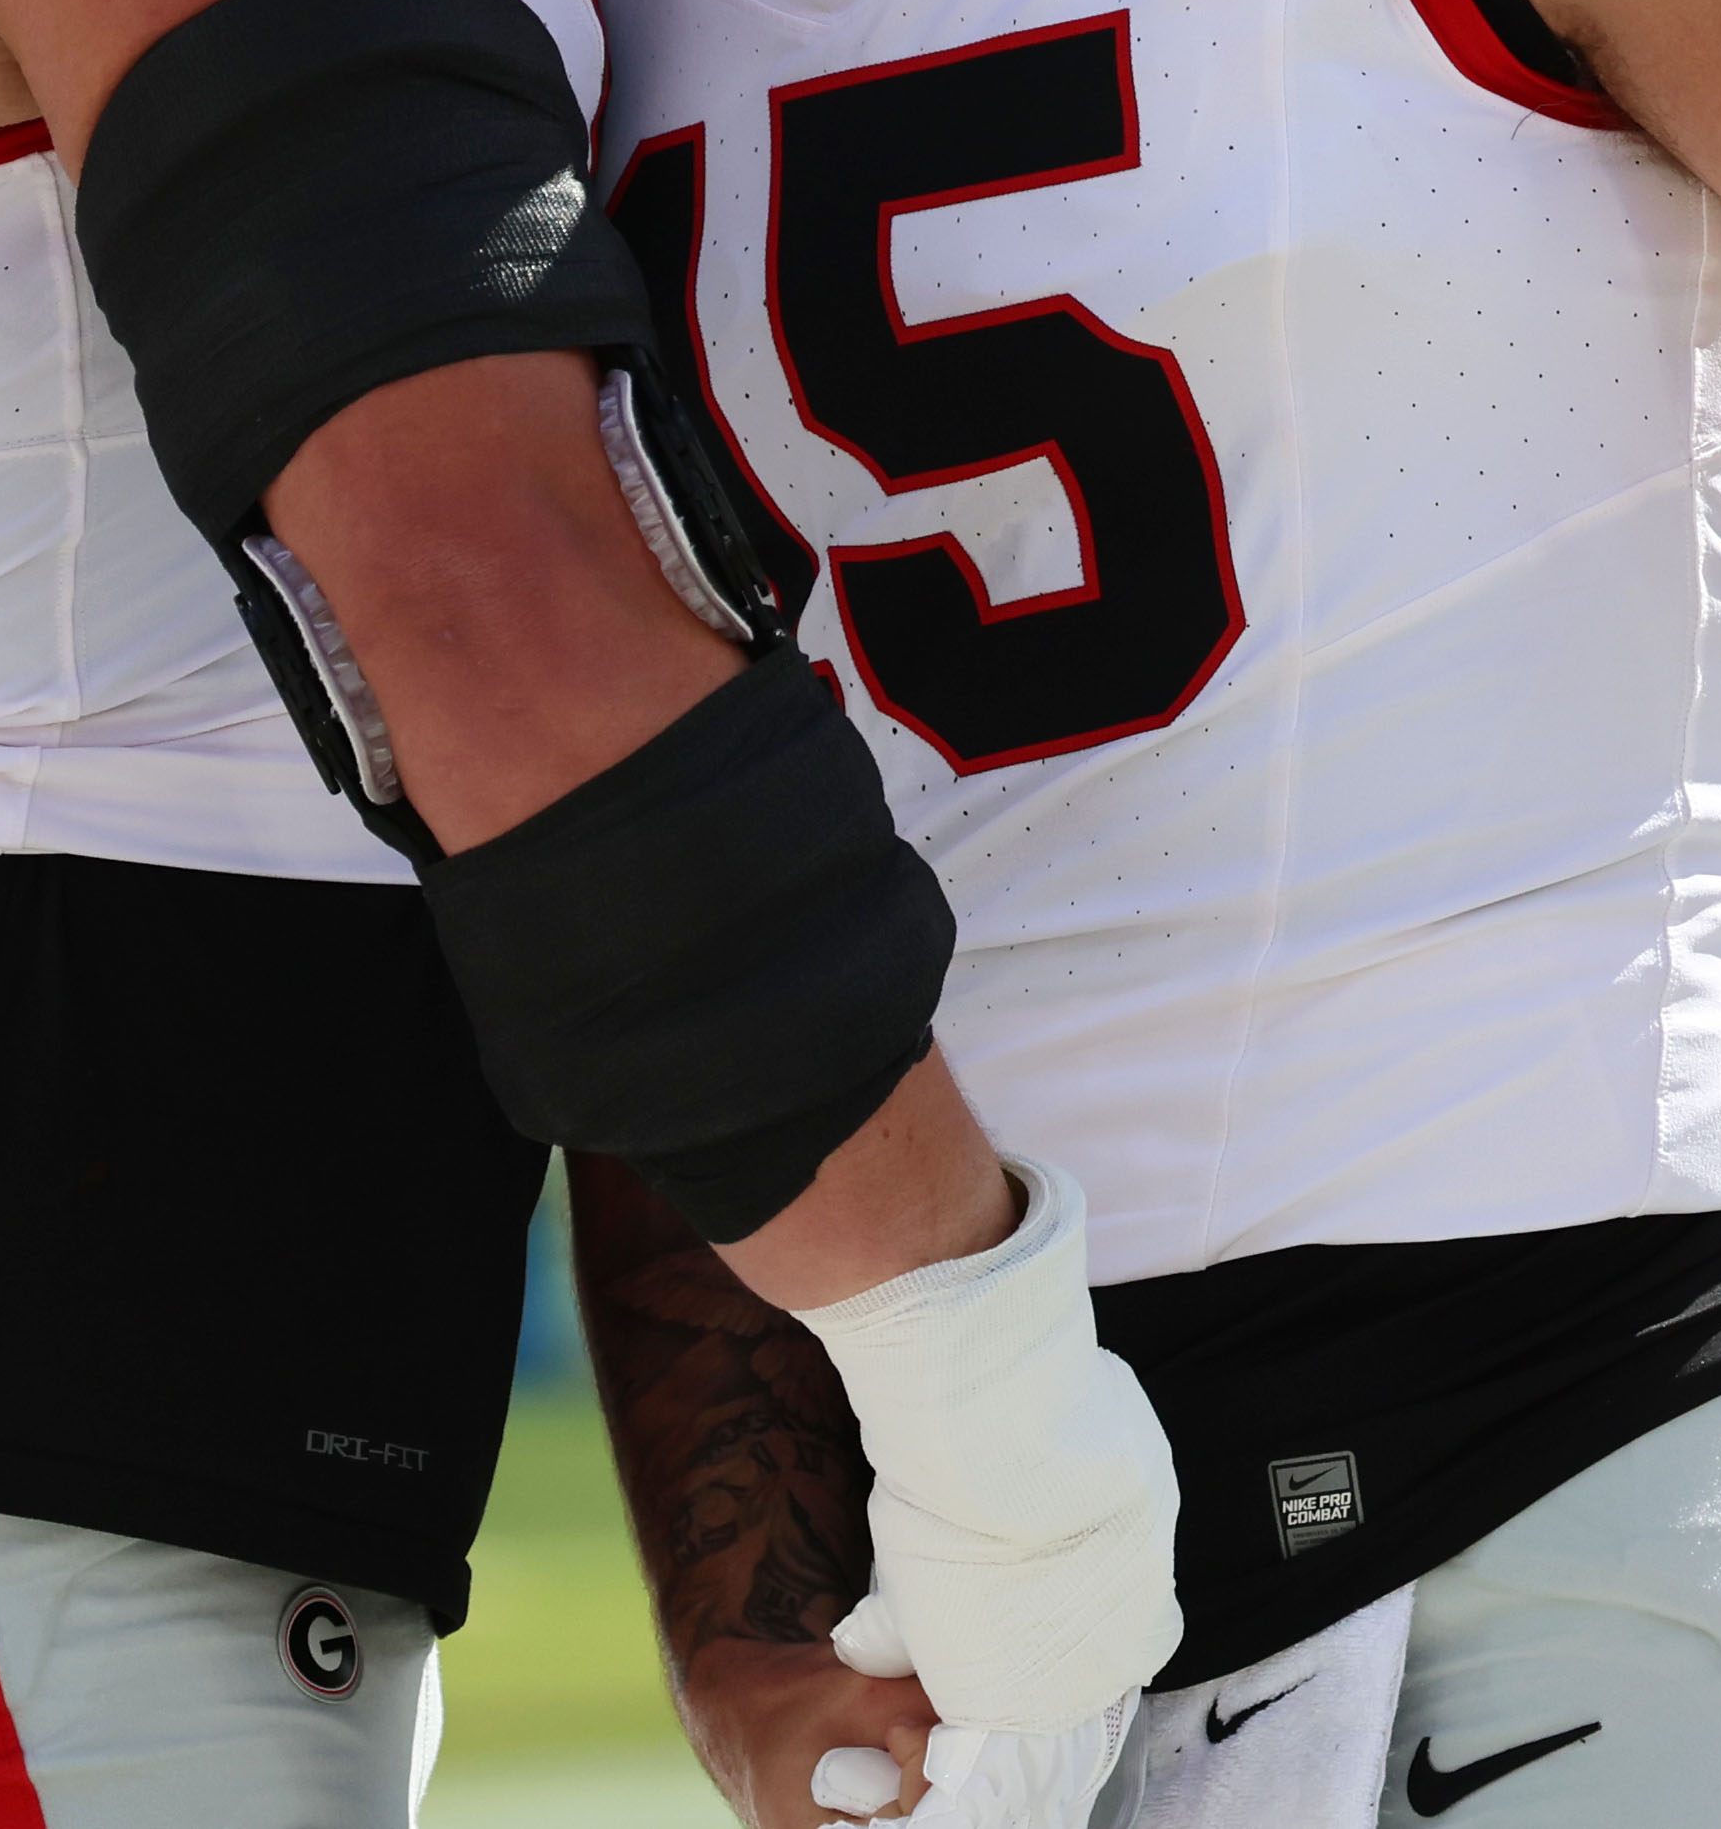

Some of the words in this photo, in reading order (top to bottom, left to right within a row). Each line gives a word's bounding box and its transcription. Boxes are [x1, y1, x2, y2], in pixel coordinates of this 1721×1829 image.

[305, 1429, 429, 1471] DRI-FIT
[1282, 1496, 1317, 1513] NIKE
[1319, 1492, 1352, 1509] PRO
[1287, 1505, 1351, 1526] COMBAT
